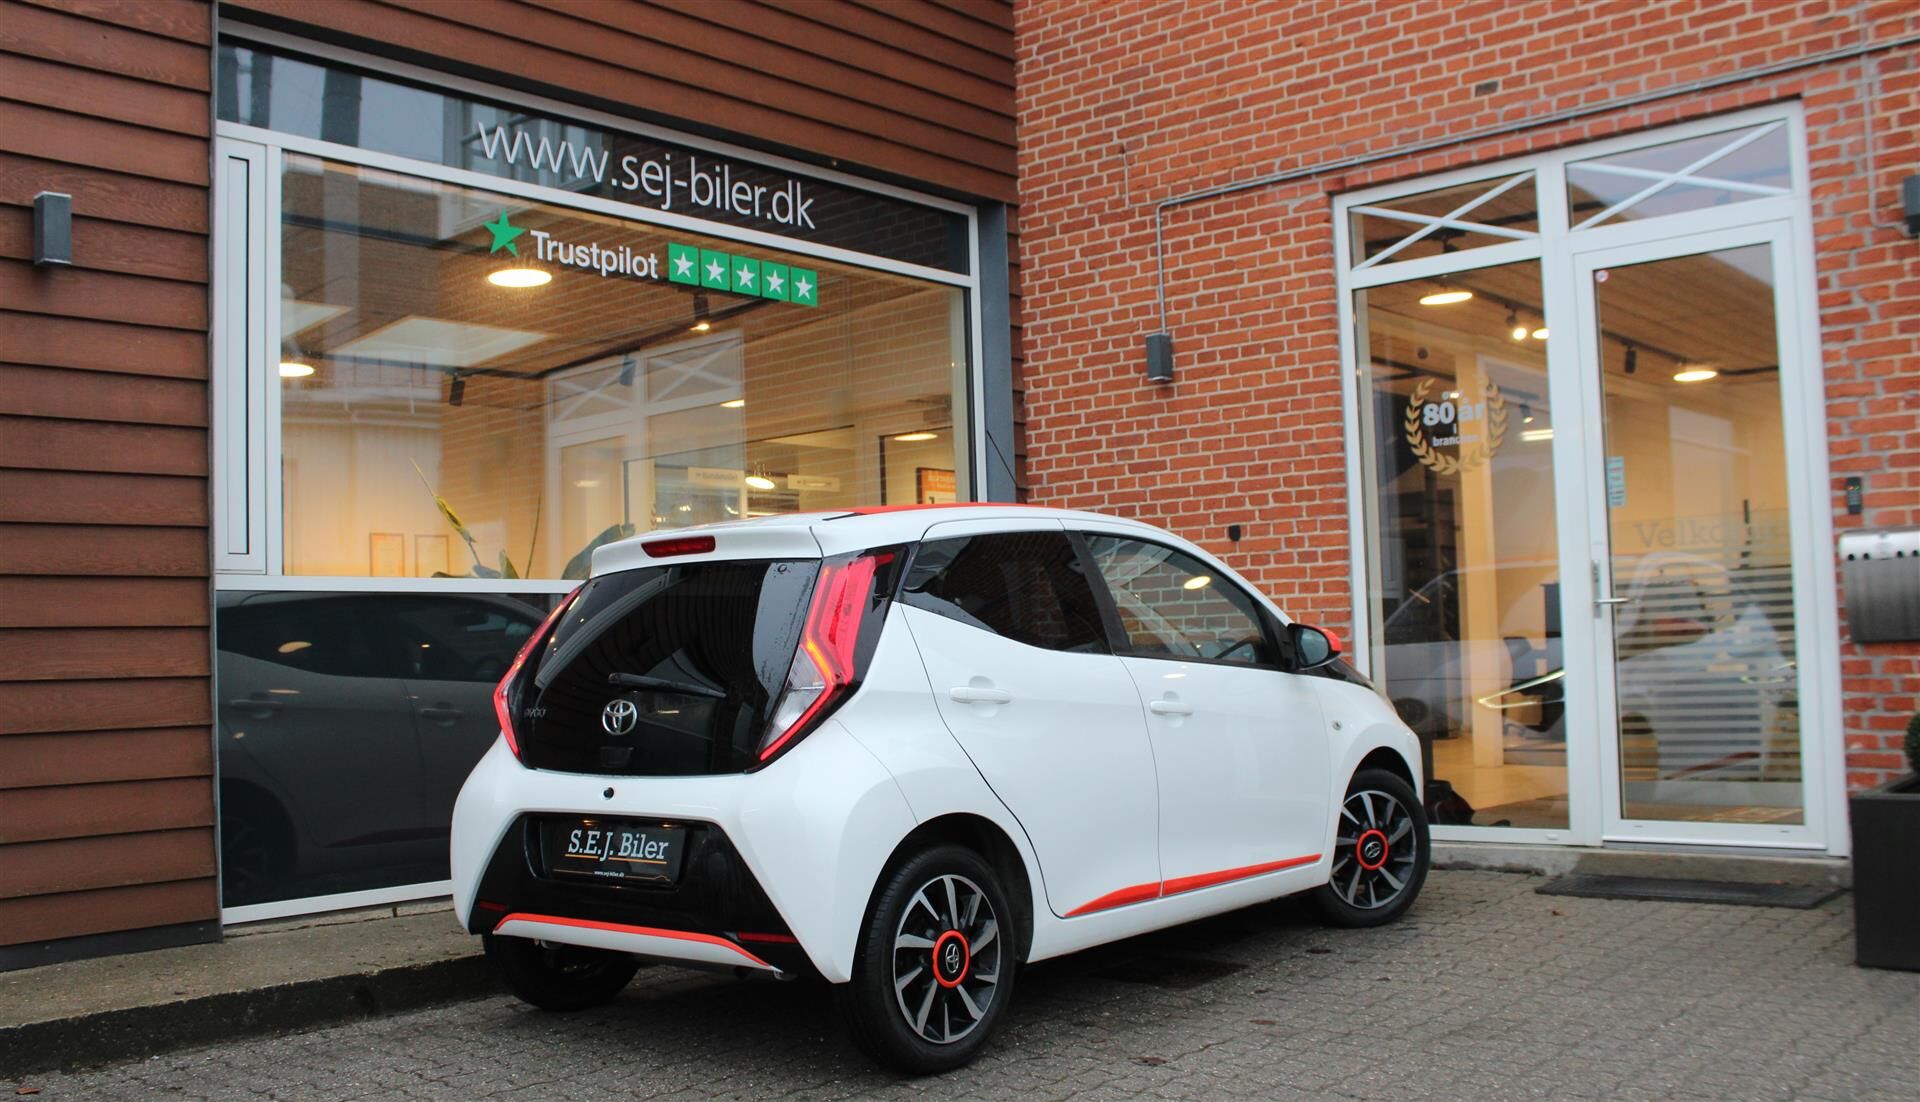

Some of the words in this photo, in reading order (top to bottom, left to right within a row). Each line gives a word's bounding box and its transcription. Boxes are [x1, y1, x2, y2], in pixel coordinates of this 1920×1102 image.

[477, 121, 815, 230] www.sej-biler.dk
[530, 229, 658, 279] Trustpilot
[1423, 401, 1455, 426] 80
[1432, 434, 1480, 447] branc
[1633, 518, 1772, 548] Velko
[568, 829, 614, 861] S.E.J.
[618, 832, 669, 860] Biler
